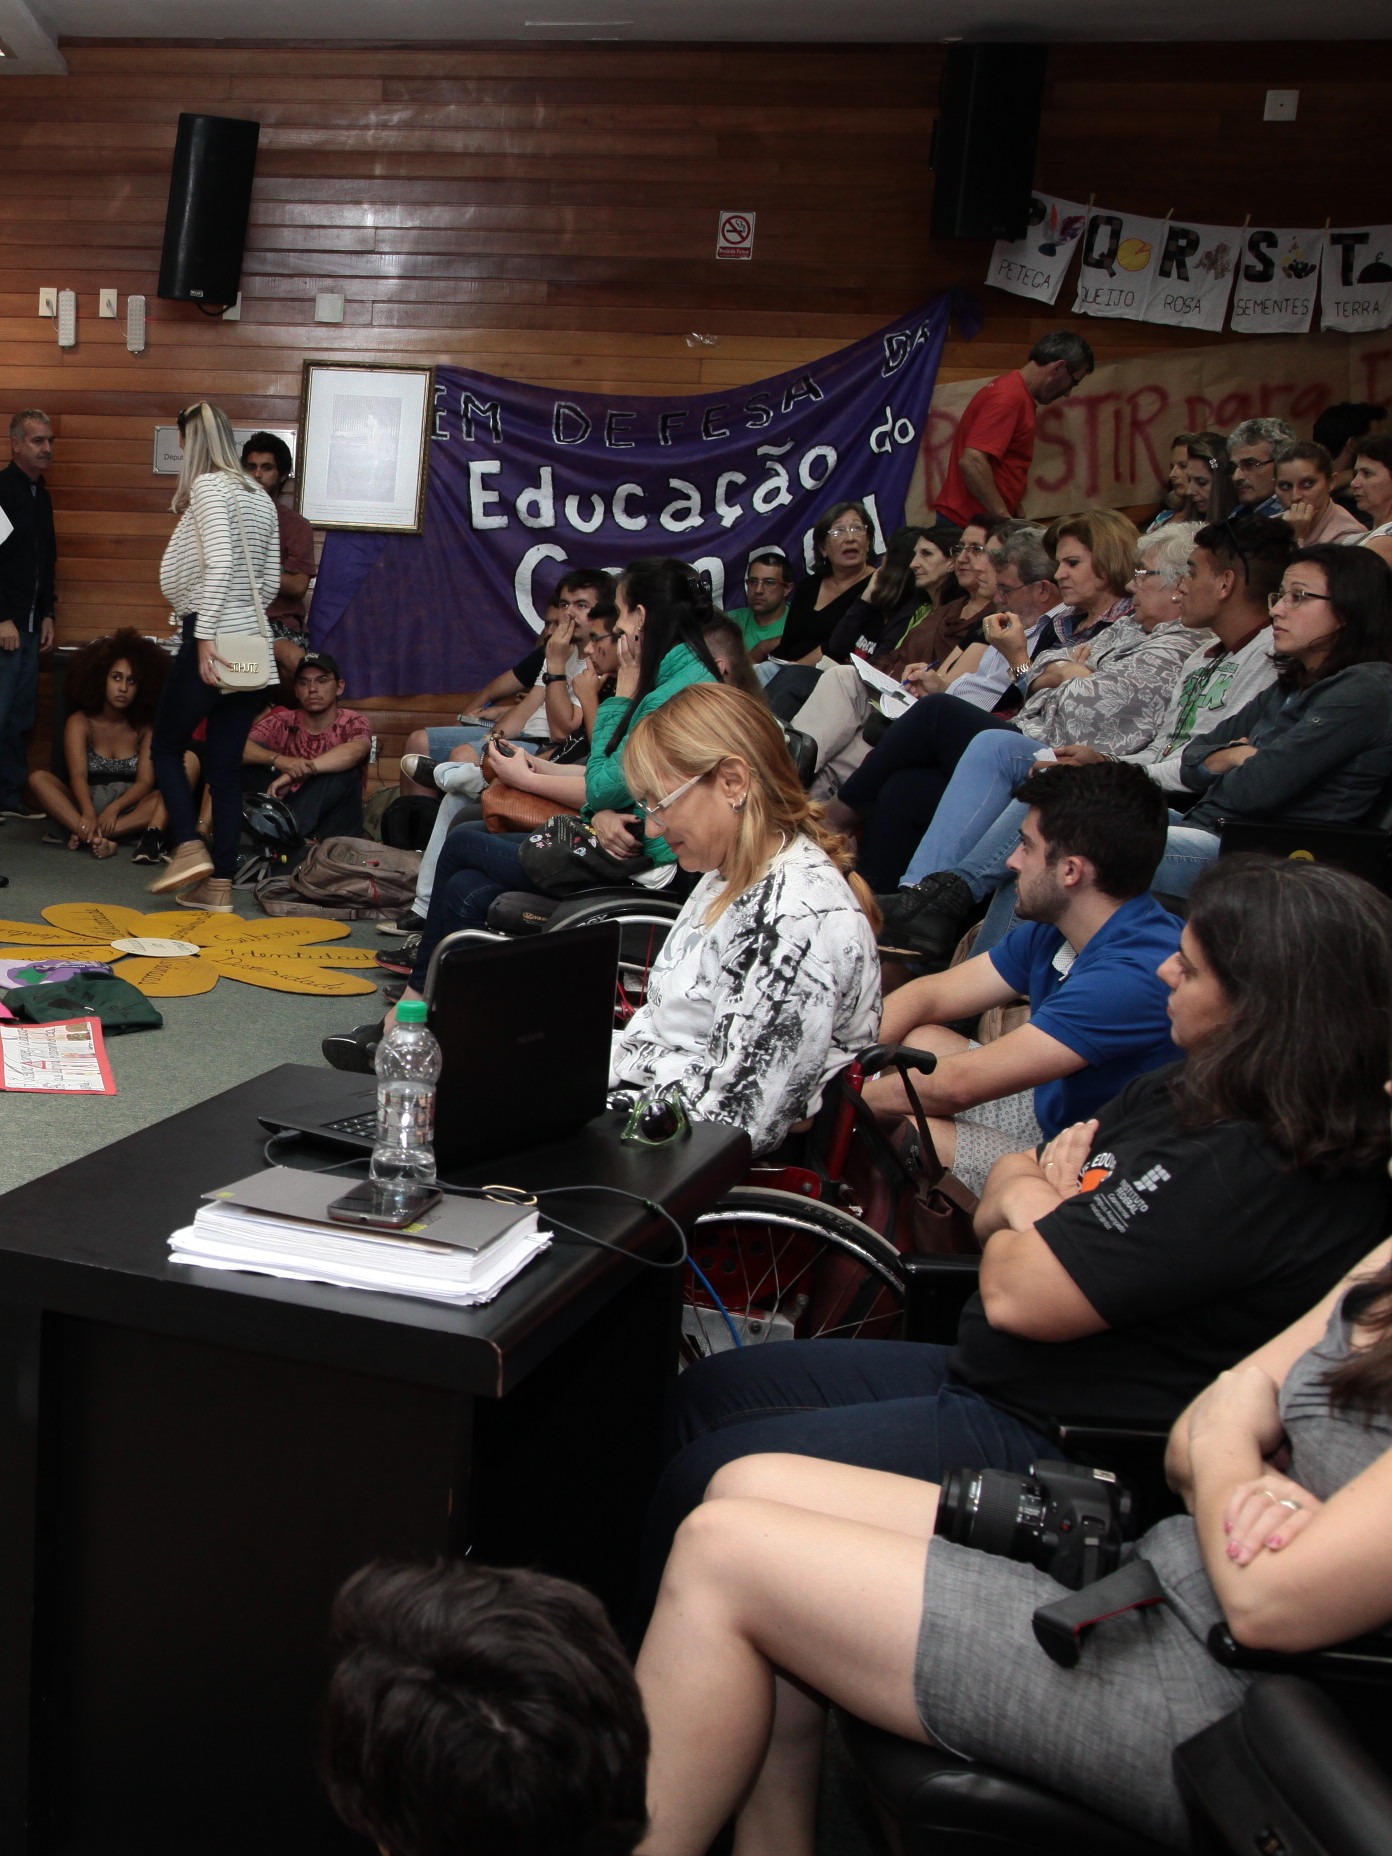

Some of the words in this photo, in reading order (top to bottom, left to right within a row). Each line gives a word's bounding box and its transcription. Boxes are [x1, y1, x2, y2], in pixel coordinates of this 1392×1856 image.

[1083, 214, 1123, 278] Q
[1159, 226, 1201, 282] R
[1244, 231, 1278, 283] S
[1330, 233, 1370, 286] T
[997, 258, 1053, 290] PETECA
[1163, 294, 1202, 314] ROSA
[1236, 298, 1309, 317] SEMENTES
[1334, 301, 1381, 317] TERRA
[431, 386, 502, 444] EM
[552, 374, 825, 449] DEFESA
[468, 438, 838, 533] Educação
[868, 405, 915, 455] do
[229, 662, 259, 674] SCHUTZ
[224, 948, 377, 961] Identidad
[1115, 1187, 1140, 1216] FEDERAL
[1120, 1178, 1149, 1213] INSTITUTO
[803, 1204, 855, 1231] KENDA
